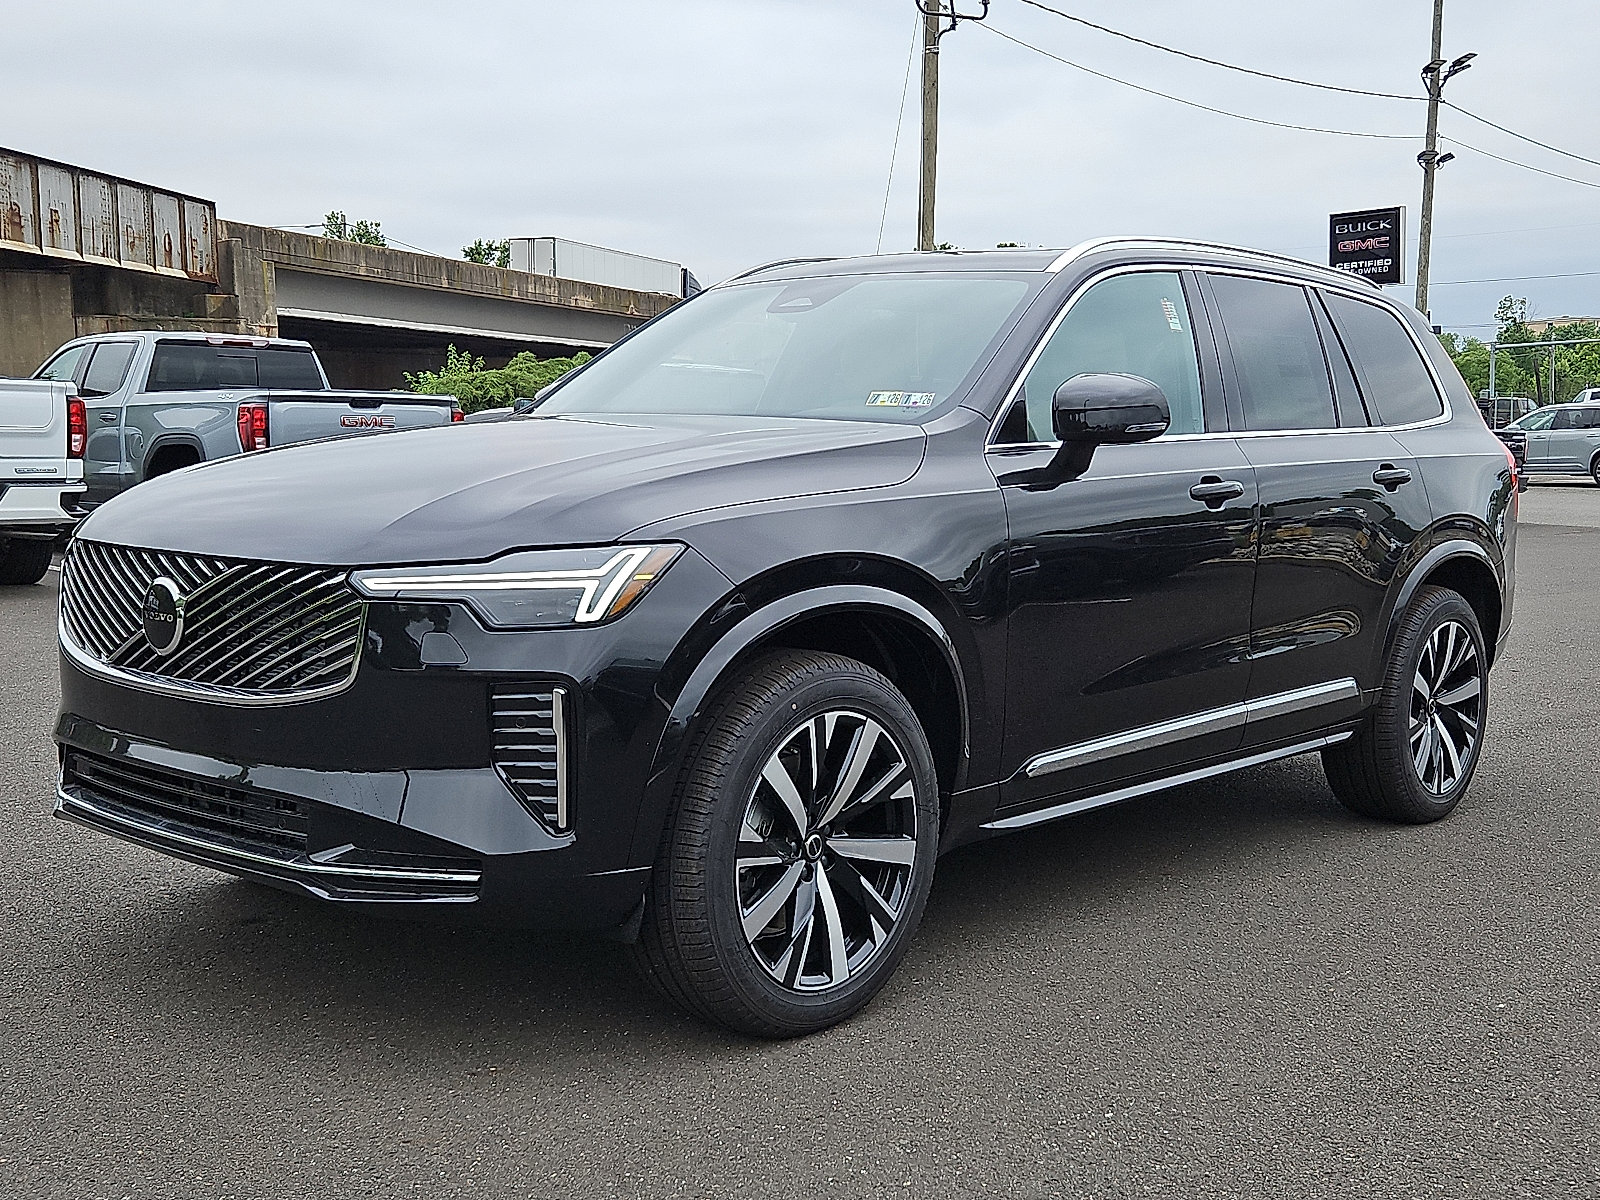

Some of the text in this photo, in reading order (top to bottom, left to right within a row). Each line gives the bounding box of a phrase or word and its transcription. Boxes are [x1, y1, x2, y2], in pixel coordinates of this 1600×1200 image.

[1336, 219, 1392, 234] BUICK
[1338, 237, 1389, 252] GMC
[1336, 259, 1391, 270] CERTIFIED
[340, 415, 396, 429] GMC
